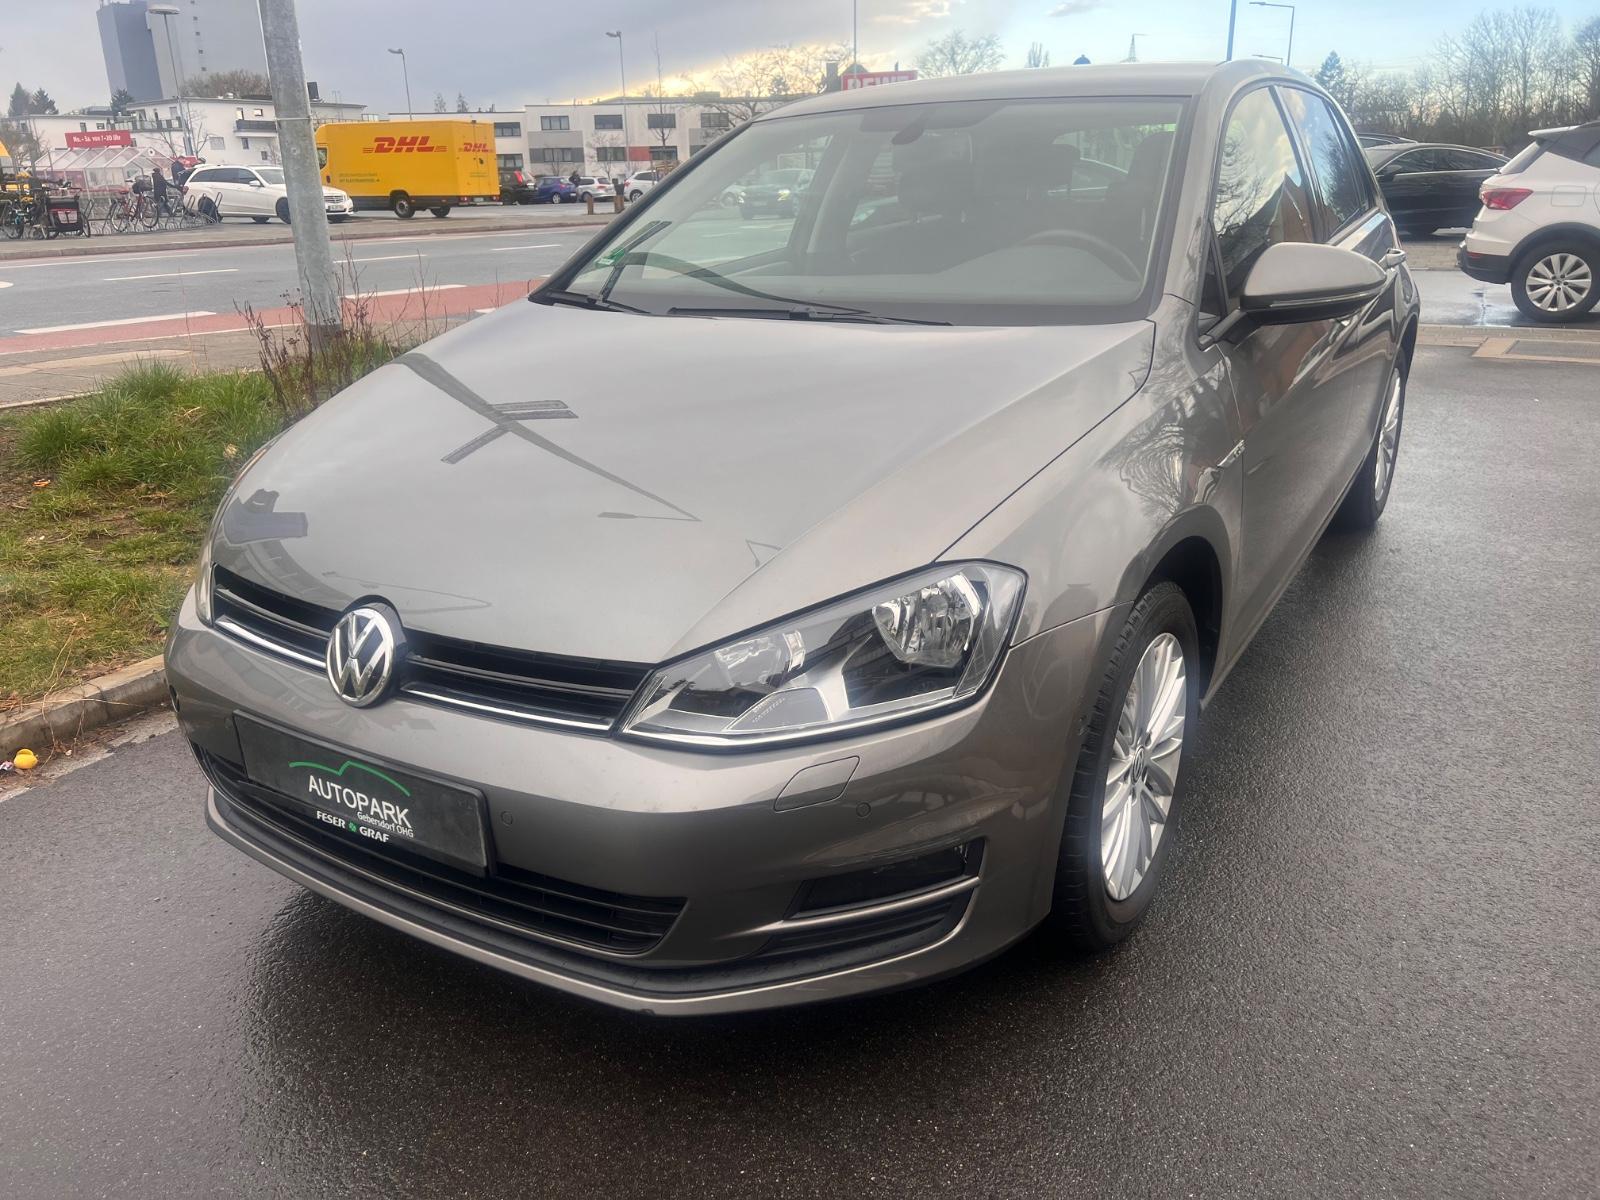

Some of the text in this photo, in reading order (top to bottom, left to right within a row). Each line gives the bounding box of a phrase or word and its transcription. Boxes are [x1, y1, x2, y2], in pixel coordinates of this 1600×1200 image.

[373, 136, 435, 154] DHL
[463, 143, 489, 152] DHL
[308, 775, 412, 829] AUTOPARK
[316, 810, 390, 843] FESER GRAF
[357, 811, 414, 838] Gebersdorf OHG
